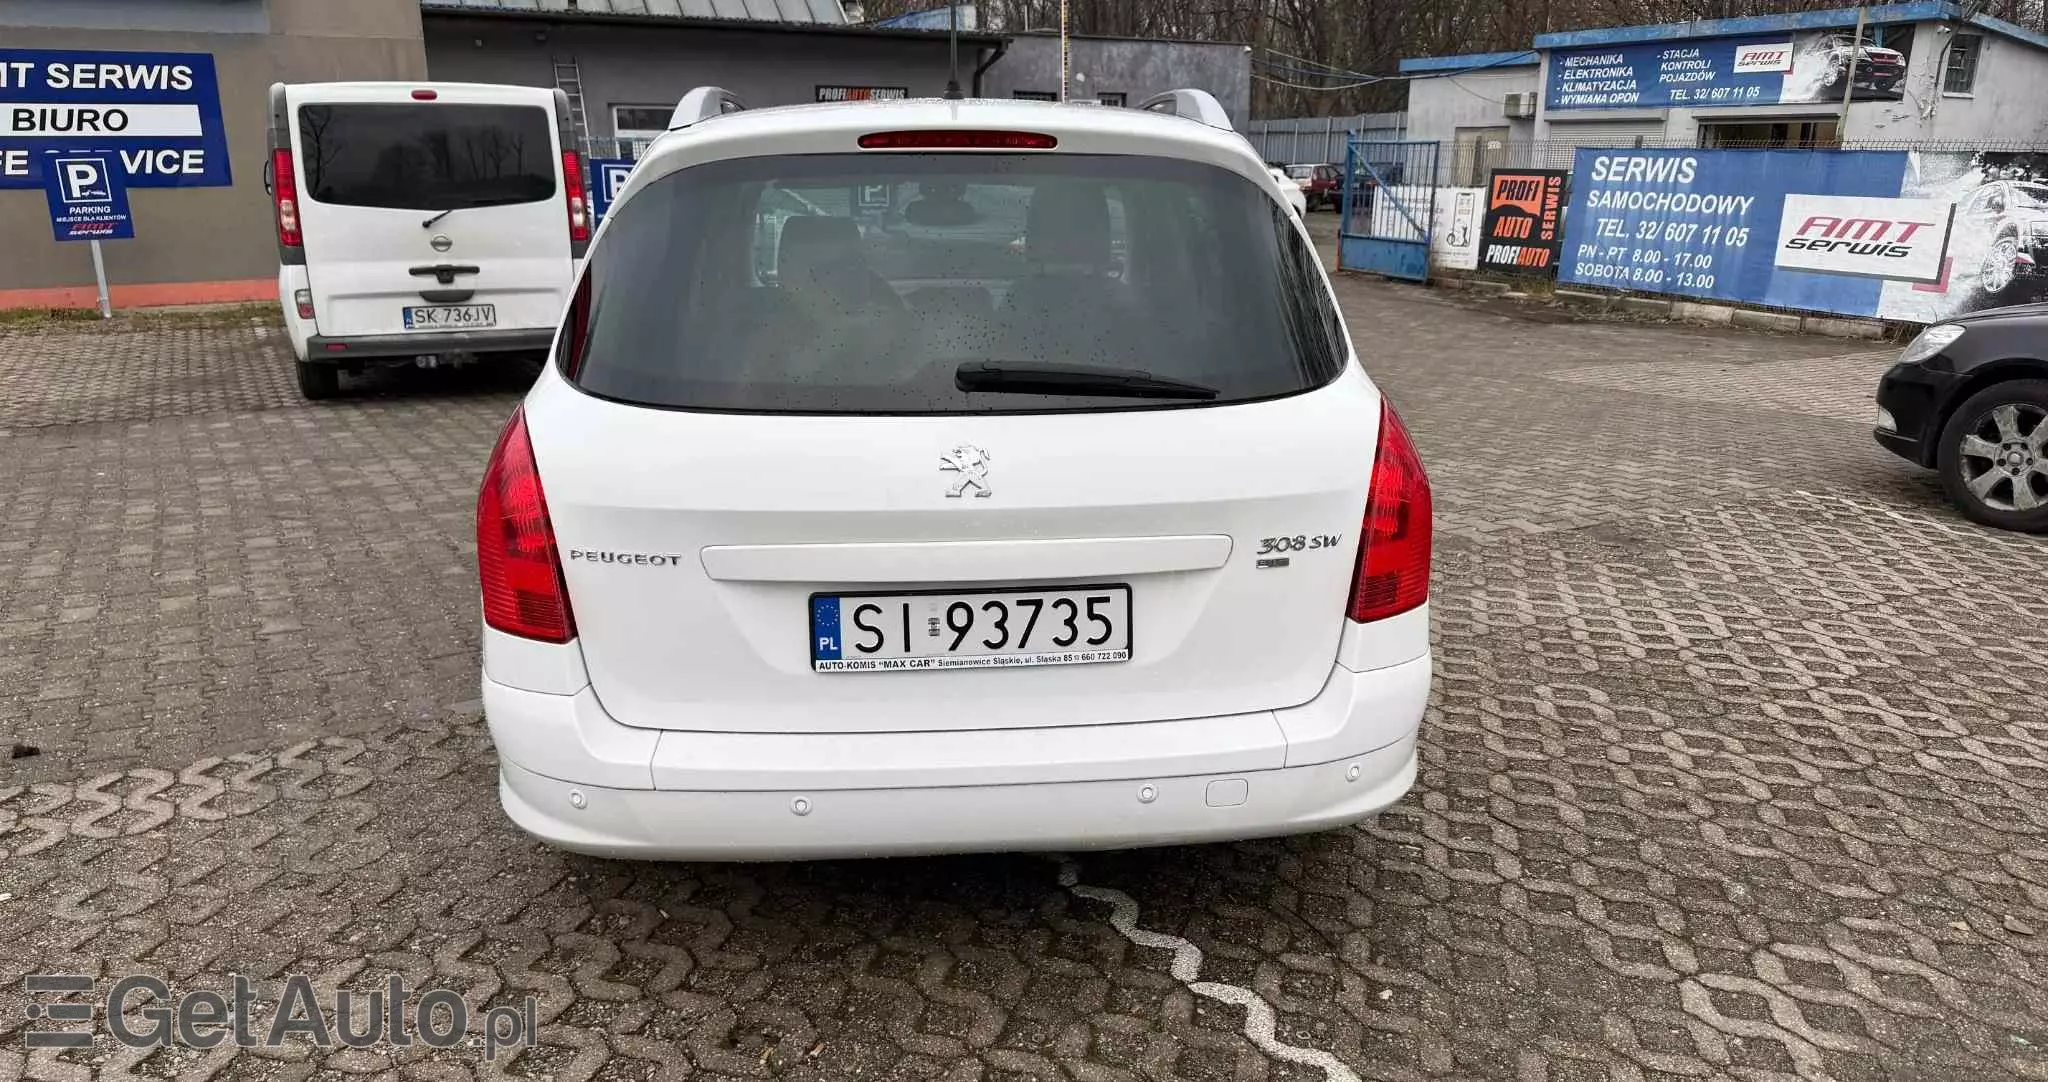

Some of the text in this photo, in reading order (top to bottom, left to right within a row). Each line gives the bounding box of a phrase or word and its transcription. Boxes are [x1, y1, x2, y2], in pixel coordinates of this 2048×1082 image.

[1564, 54, 1624, 67] MECHANIKA
[1660, 59, 1712, 71] KONTROLI
[1662, 48, 1699, 60] STACJA
[46, 62, 193, 90] SERWIS
[1563, 66, 1634, 80] ELEKTRONIKA
[1659, 70, 1716, 83] POJAZDÓW
[819, 87, 906, 100] PROFIAUTOSERWIS
[1561, 80, 1637, 92] KLIMATYZACJA
[1669, 86, 1760, 100] TEL. 32/ 607 11 05
[1560, 93, 1607, 105] WYMIANA
[1609, 92, 1640, 104] OPON
[12, 108, 129, 131] BIURO
[67, 164, 98, 198] P
[1591, 156, 1698, 184] SERWIS
[1496, 179, 1541, 202] PROFI
[69, 206, 111, 215] PARKING
[1541, 176, 1562, 241] SERWIS
[1586, 189, 1755, 216] SAMOCHODOWY
[1493, 216, 1533, 239] AUTO
[1595, 218, 1750, 247] TEL. 32/ 607 11 05
[1796, 216, 1936, 244] AMT
[1485, 244, 1551, 268] PROFIAUTO
[1577, 244, 1597, 258] PN
[1606, 246, 1628, 261] PT
[1632, 249, 1661, 264] 8.00
[1673, 252, 1713, 270] 17.00
[1785, 238, 1913, 258] serwis
[1575, 262, 1630, 280] SOBOTA
[1632, 267, 1664, 284] 8.00
[1676, 271, 1715, 289] 13.00
[414, 307, 491, 323] SK 736JV
[1256, 533, 1343, 555] 308 SW
[569, 549, 682, 566] PEUGEOT
[819, 595, 1113, 654] PL SI 93735
[819, 660, 877, 670] AUTO-KOMIS
